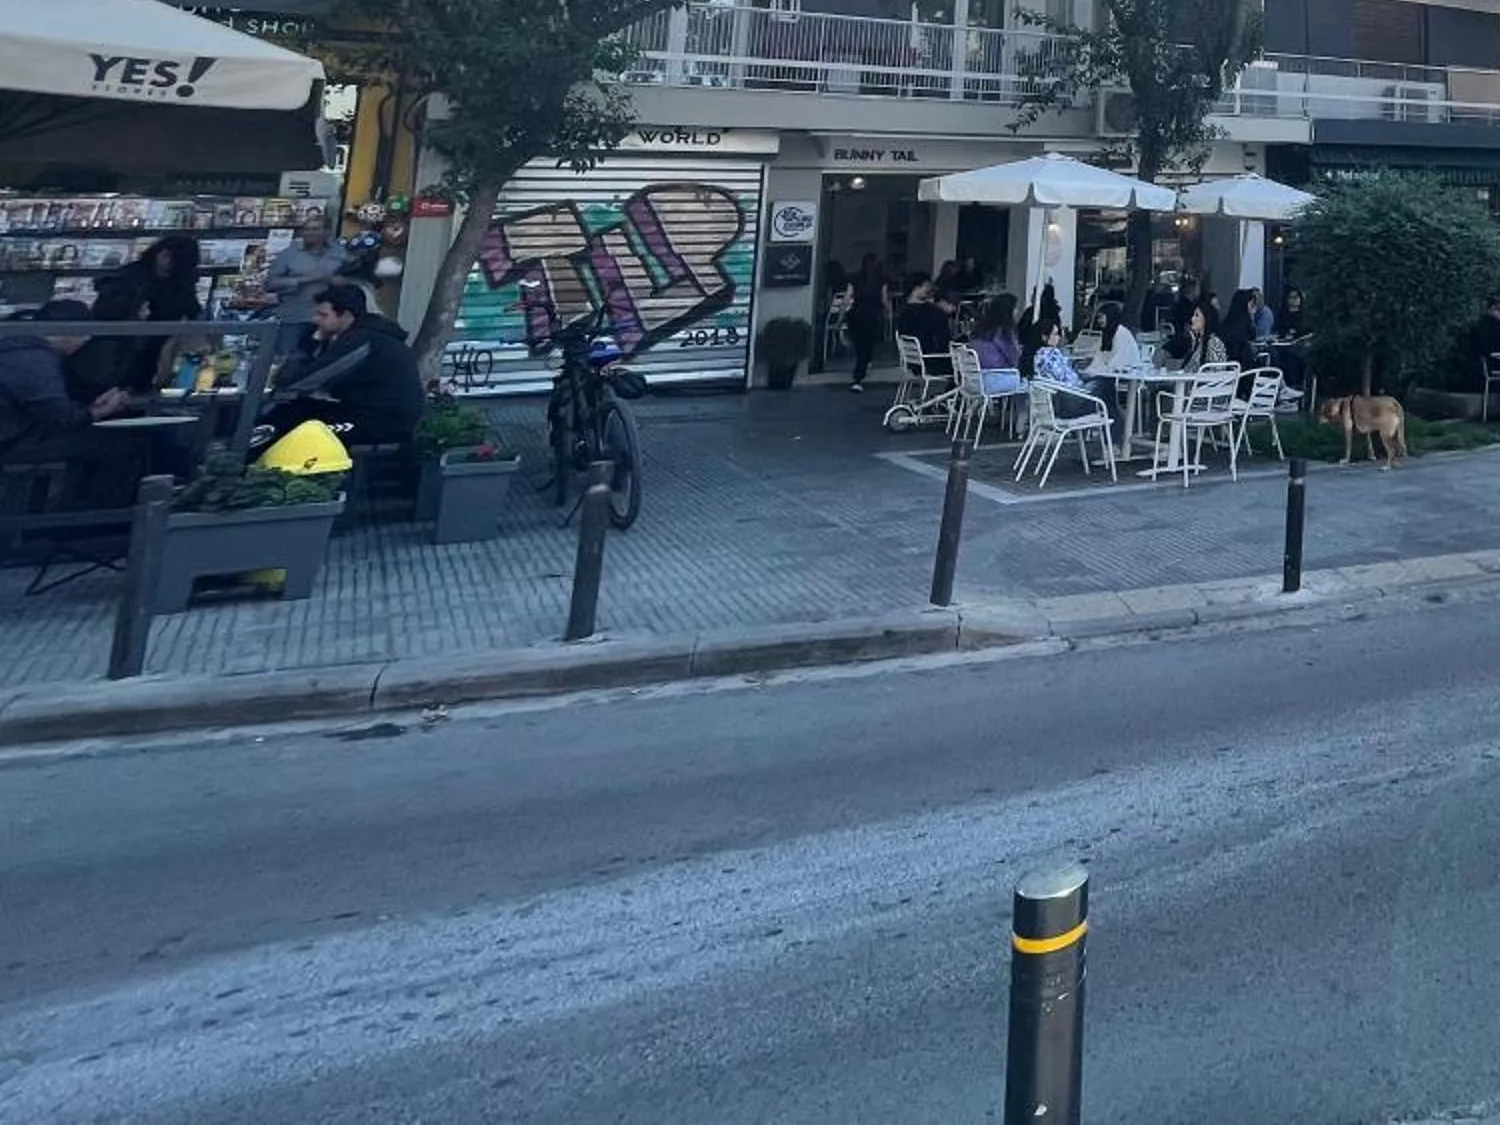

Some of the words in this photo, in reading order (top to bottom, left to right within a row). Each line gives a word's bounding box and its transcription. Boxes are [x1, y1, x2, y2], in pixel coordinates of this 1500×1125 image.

[88, 53, 218, 97] YES!
[637, 130, 721, 146] WORLD
[834, 148, 885, 162] BUNNY
